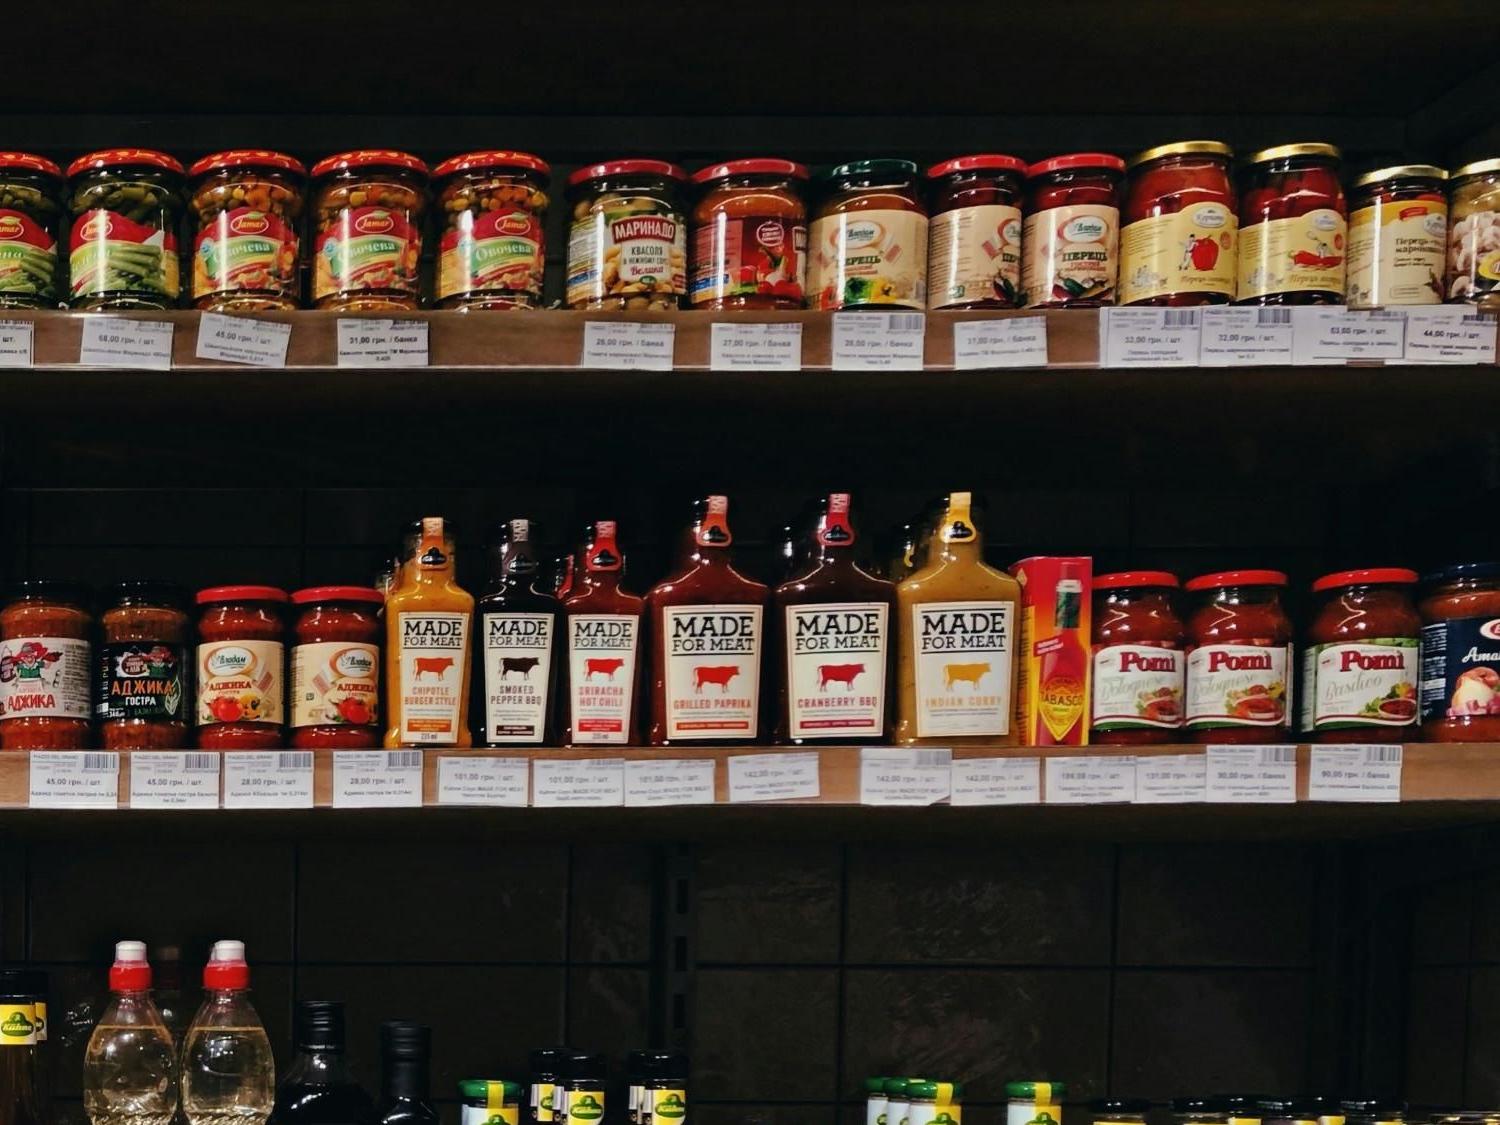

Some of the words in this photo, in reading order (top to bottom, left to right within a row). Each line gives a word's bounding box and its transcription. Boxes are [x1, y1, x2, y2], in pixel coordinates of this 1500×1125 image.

[236, 220, 266, 232] Jamar
[360, 219, 389, 230] Jamar
[614, 222, 674, 240] МАРИНАДО
[476, 244, 531, 261] Овочева
[631, 246, 663, 256] КВАСОЛЯ
[1063, 251, 1107, 262] ПЕРЕЦЬ
[404, 620, 462, 637] MADE
[489, 620, 548, 637] MADE
[574, 622, 633, 638] MADE
[404, 636, 430, 647] FOR
[432, 636, 462, 647] MEAT
[490, 637, 516, 647] FOR
[517, 636, 549, 647] MEAT
[574, 637, 601, 647] FOR
[601, 637, 633, 647] MEAT
[112, 680, 174, 697] АДЖИКА
[412, 686, 450, 695] CHIPOTLE
[499, 685, 534, 695] SMOKED
[578, 686, 624, 696] SRIRACHA
[1326, 672, 1382, 699] Basilico
[8, 694, 56, 710] АДЖИКА
[126, 696, 156, 706] ГОСТРА
[404, 696, 433, 705] BURGER
[491, 695, 521, 705] PEPPER
[523, 695, 541, 705] BBQ
[579, 697, 598, 706] HOT
[674, 699, 711, 709] GRILLED
[714, 698, 752, 708] PAPRIKA
[798, 697, 856, 708] CRANBERRY
[859, 696, 877, 707] BBQ
[1041, 694, 1083, 706] TABASCO
